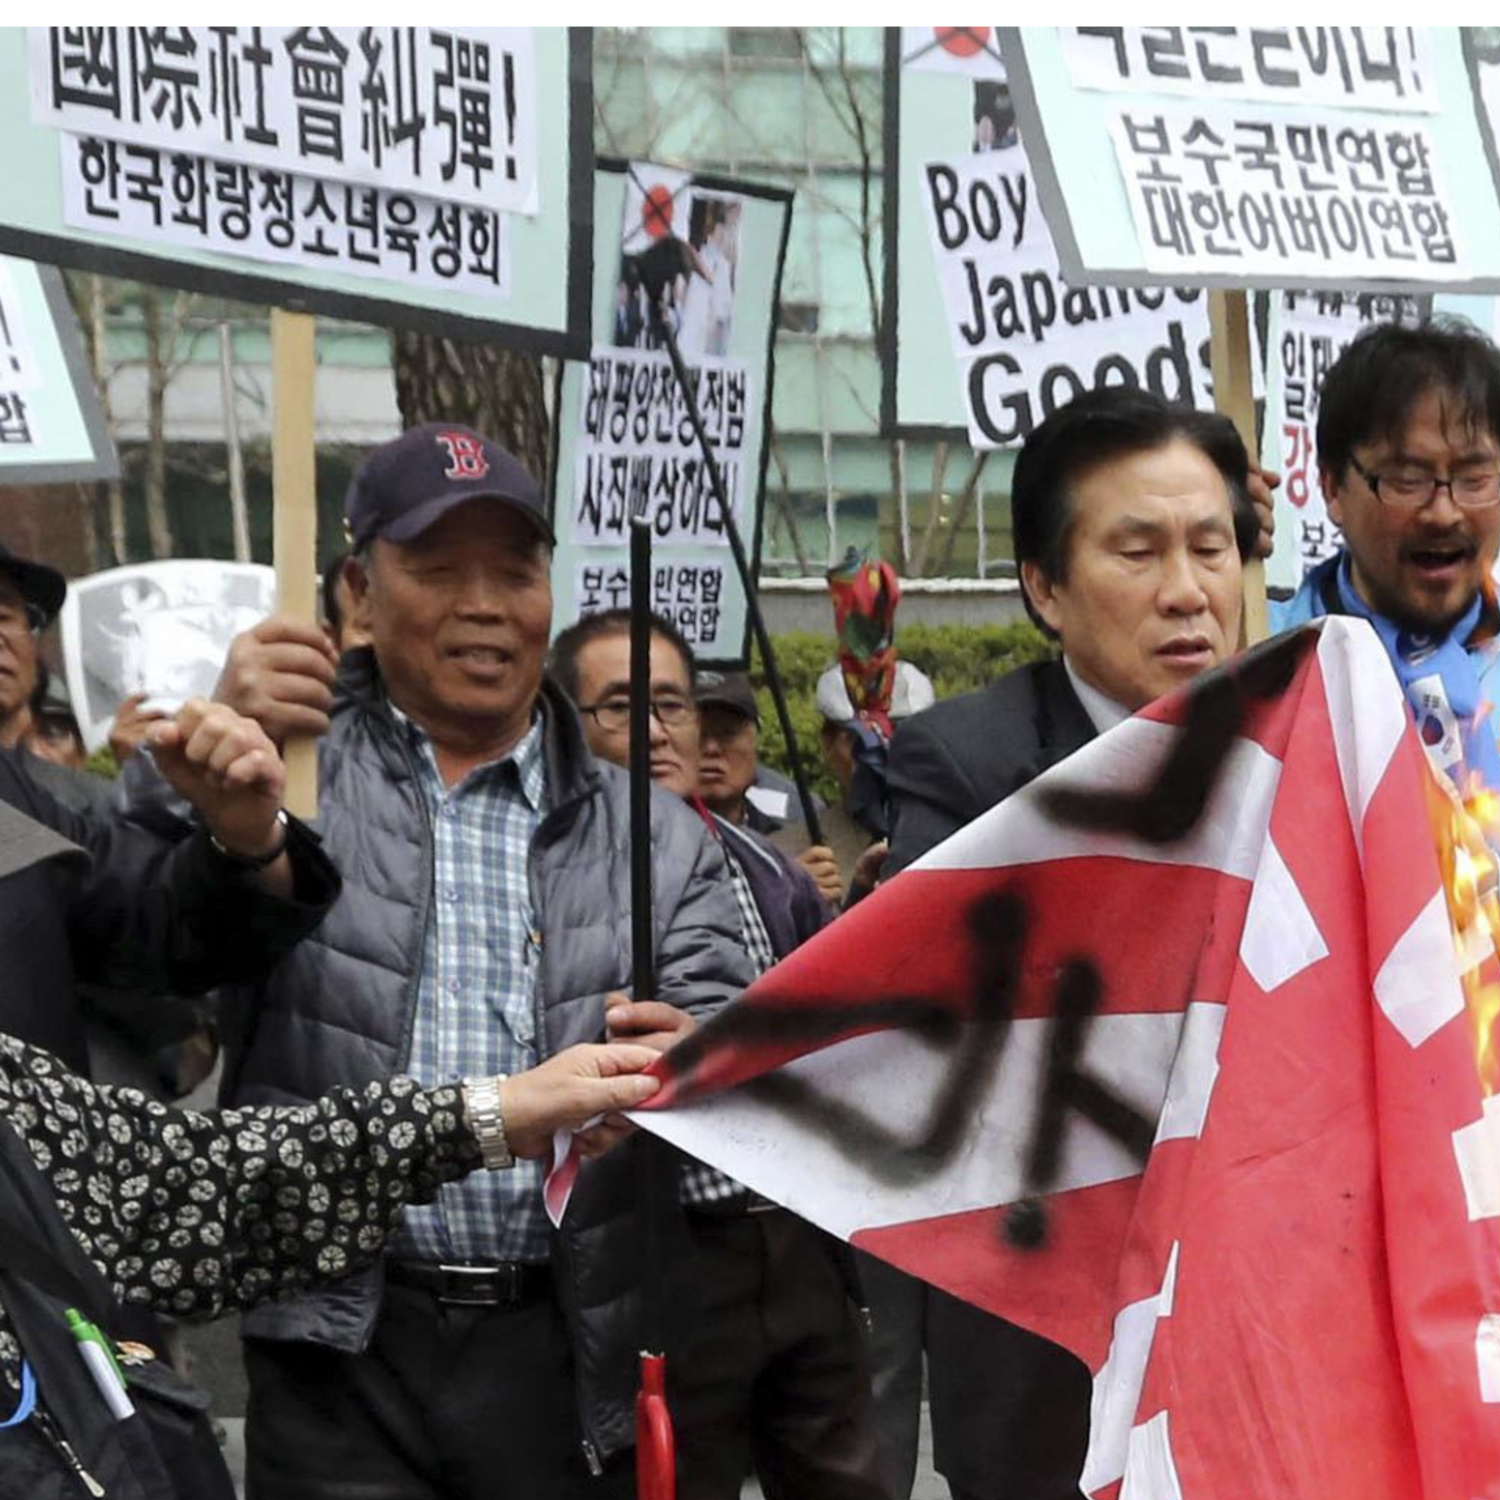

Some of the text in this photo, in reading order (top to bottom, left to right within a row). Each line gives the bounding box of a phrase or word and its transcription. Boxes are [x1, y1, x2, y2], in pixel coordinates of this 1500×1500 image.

[1121, 113, 1435, 196] 보수국민연합
[79, 136, 500, 285] 한국화랑청소년육성회
[926, 164, 1027, 249] Boy
[1140, 185, 1457, 263] 대한어버이연합
[435, 430, 490, 481] B
[580, 565, 723, 607] 보수민연합
